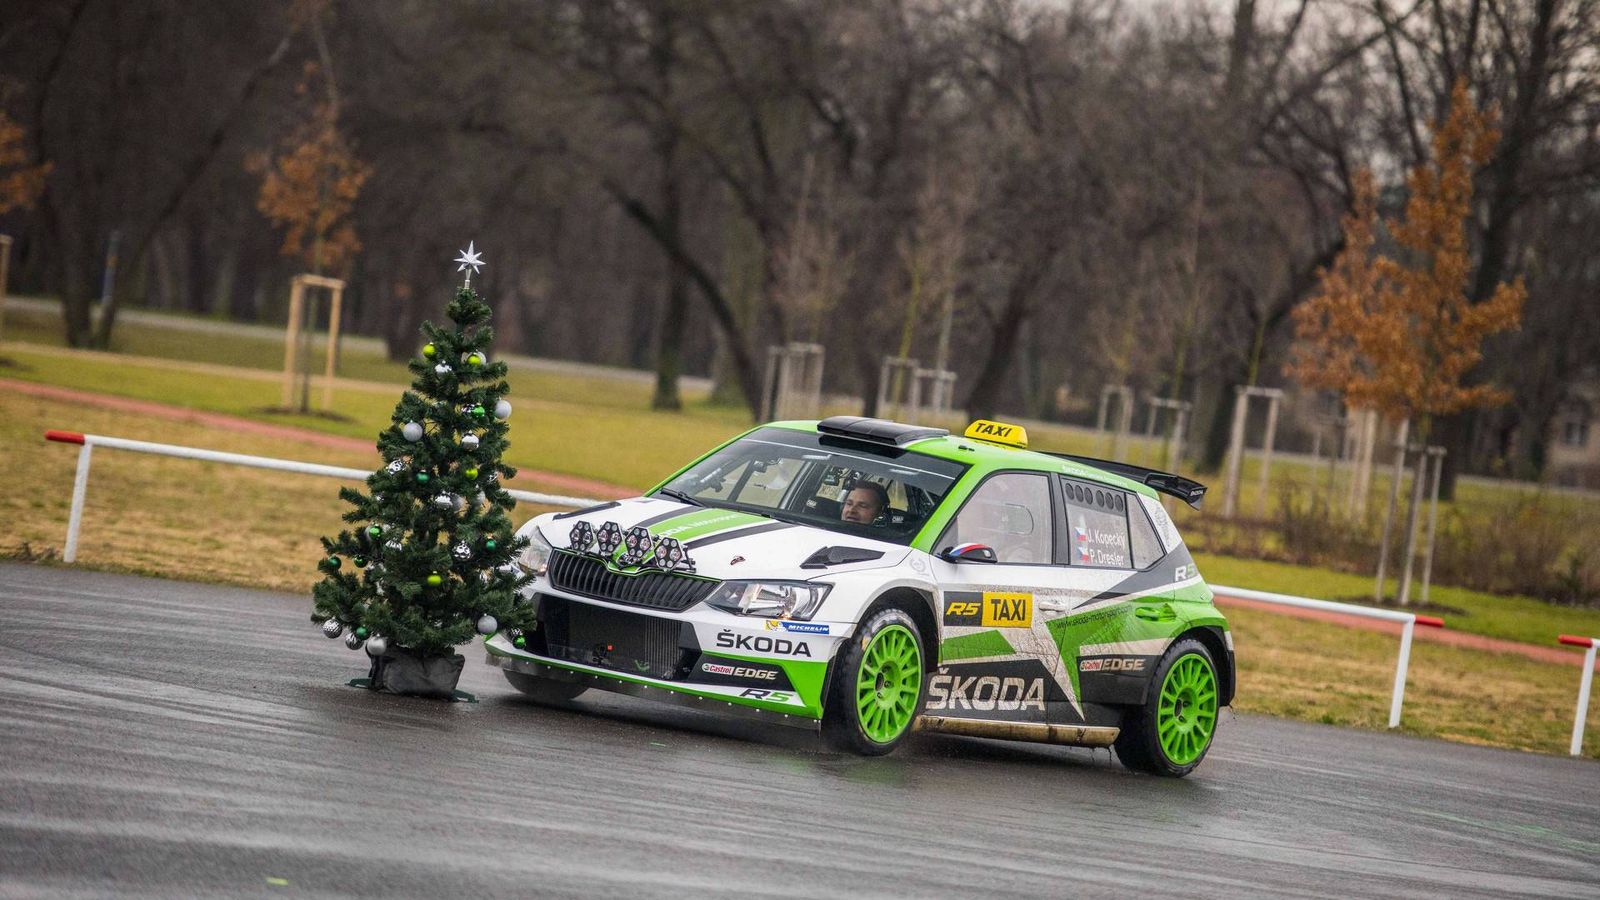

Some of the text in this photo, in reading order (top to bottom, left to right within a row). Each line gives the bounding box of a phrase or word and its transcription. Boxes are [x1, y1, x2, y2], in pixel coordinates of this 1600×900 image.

[975, 423, 1013, 437] TAXI
[1175, 563, 1197, 582] R5
[946, 602, 981, 616] R5
[990, 599, 1026, 621] TAXI
[788, 624, 829, 632] MICHELIN
[716, 629, 812, 657] ŠKODA
[1102, 659, 1146, 671] EDGE
[709, 665, 779, 680] Castrol EDGE
[739, 689, 793, 702] R5
[925, 668, 1046, 711] ŠKODA
